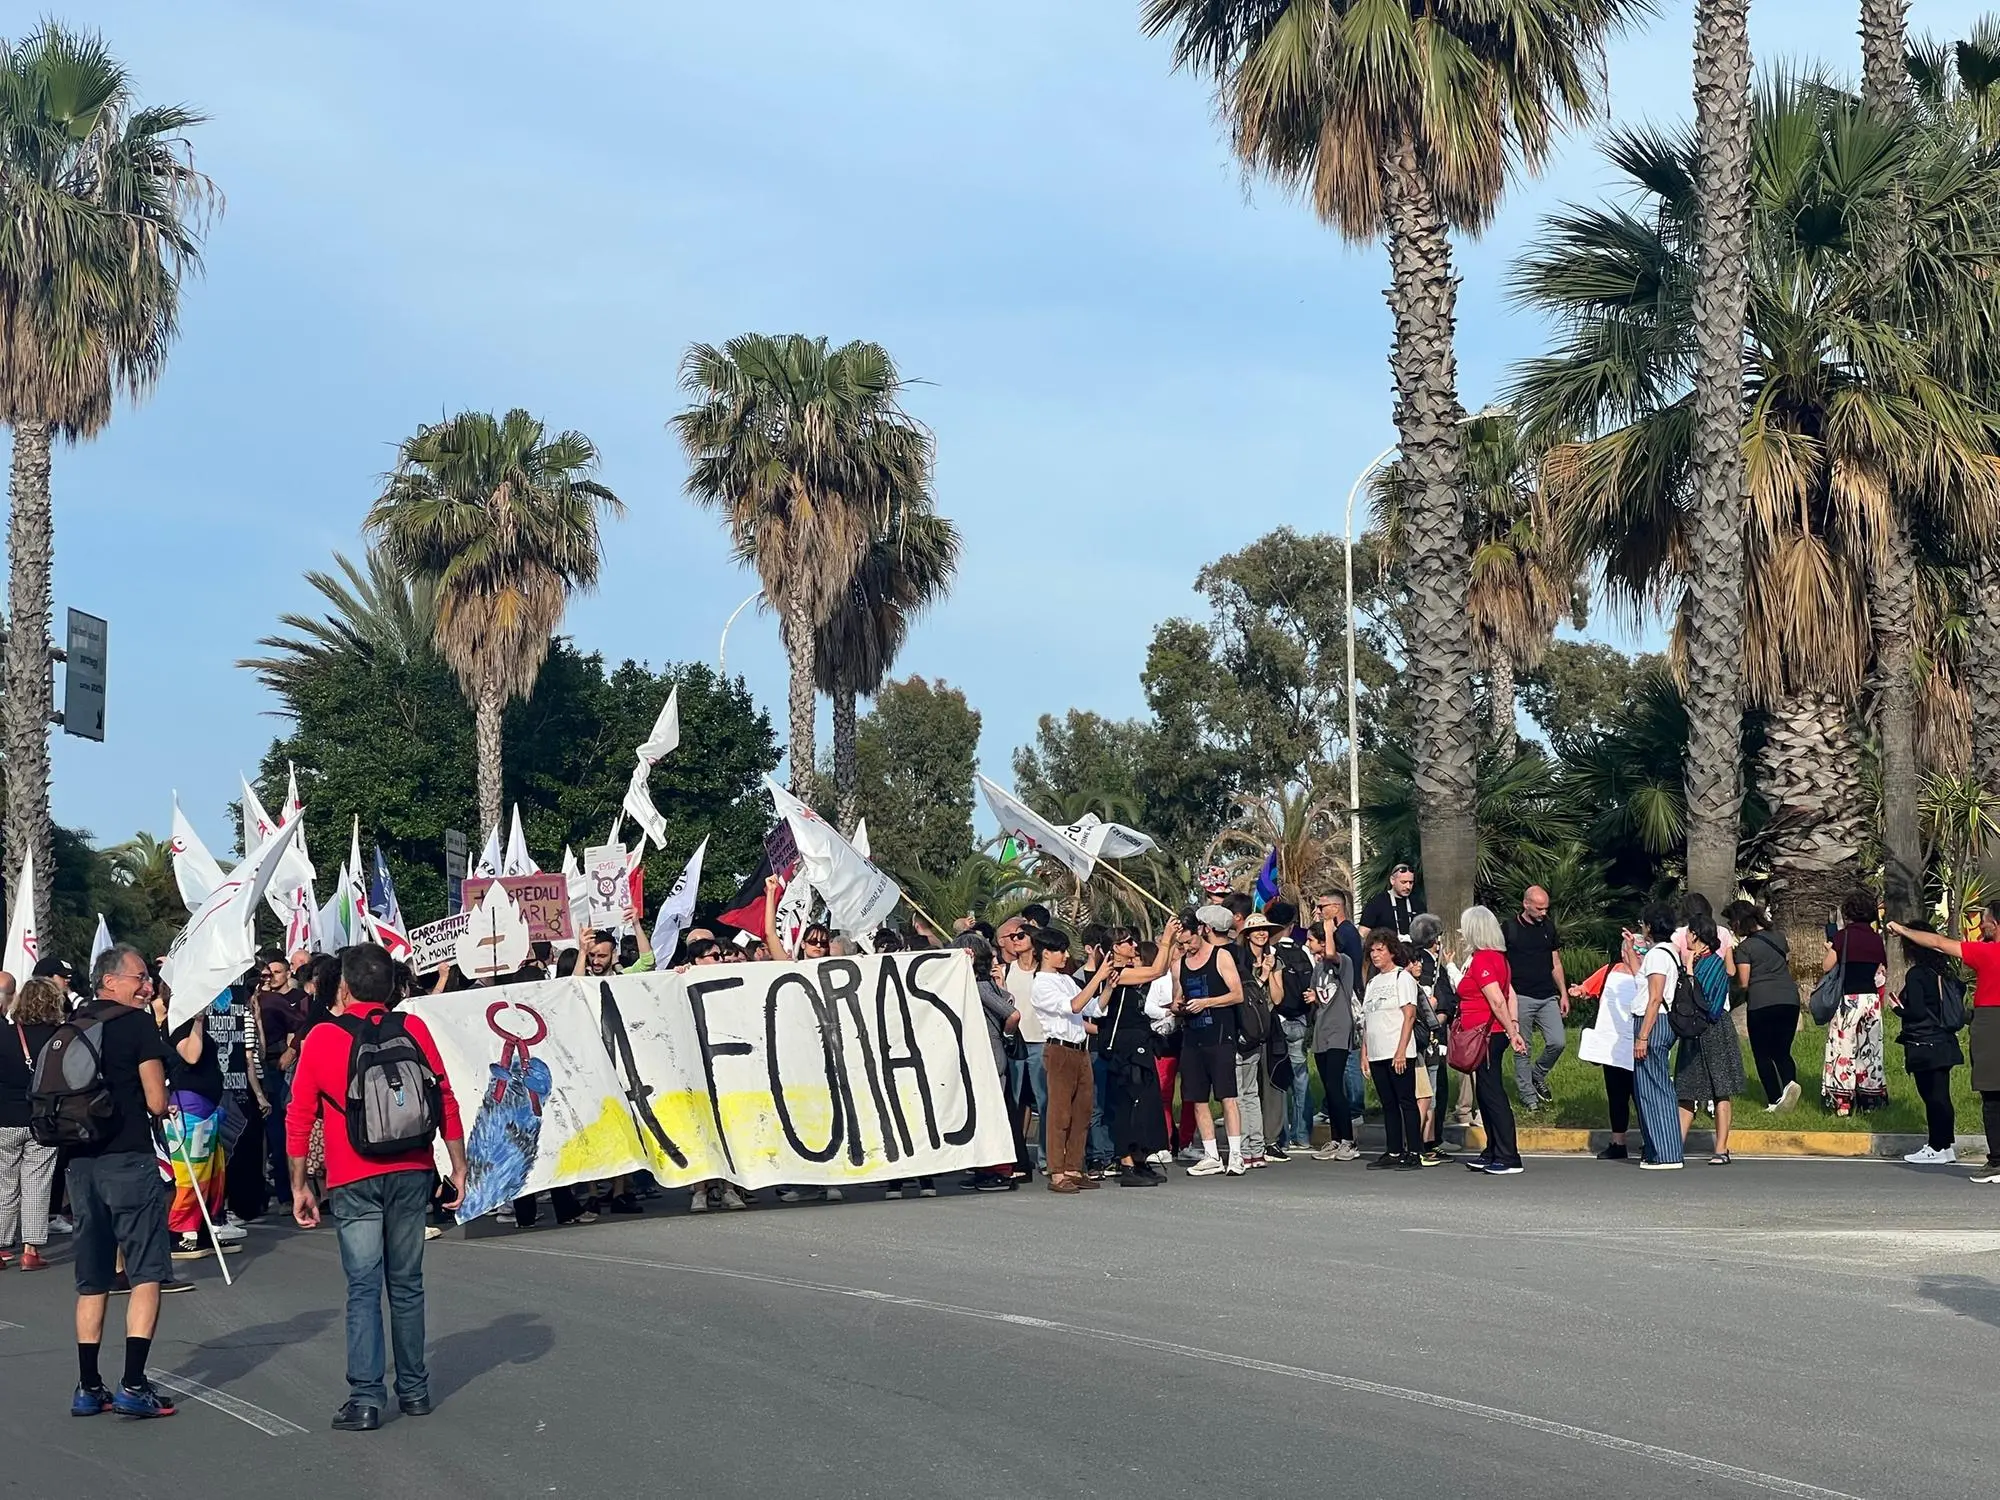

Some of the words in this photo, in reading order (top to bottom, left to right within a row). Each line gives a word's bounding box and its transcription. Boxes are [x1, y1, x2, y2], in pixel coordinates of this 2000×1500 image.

[508, 886, 559, 903] SPEDALI
[519, 904, 546, 924] ARI
[411, 925, 435, 941] CARO
[436, 914, 471, 933] AFFITTI?
[415, 954, 426, 966] LA
[687, 953, 977, 1175] FORAS
